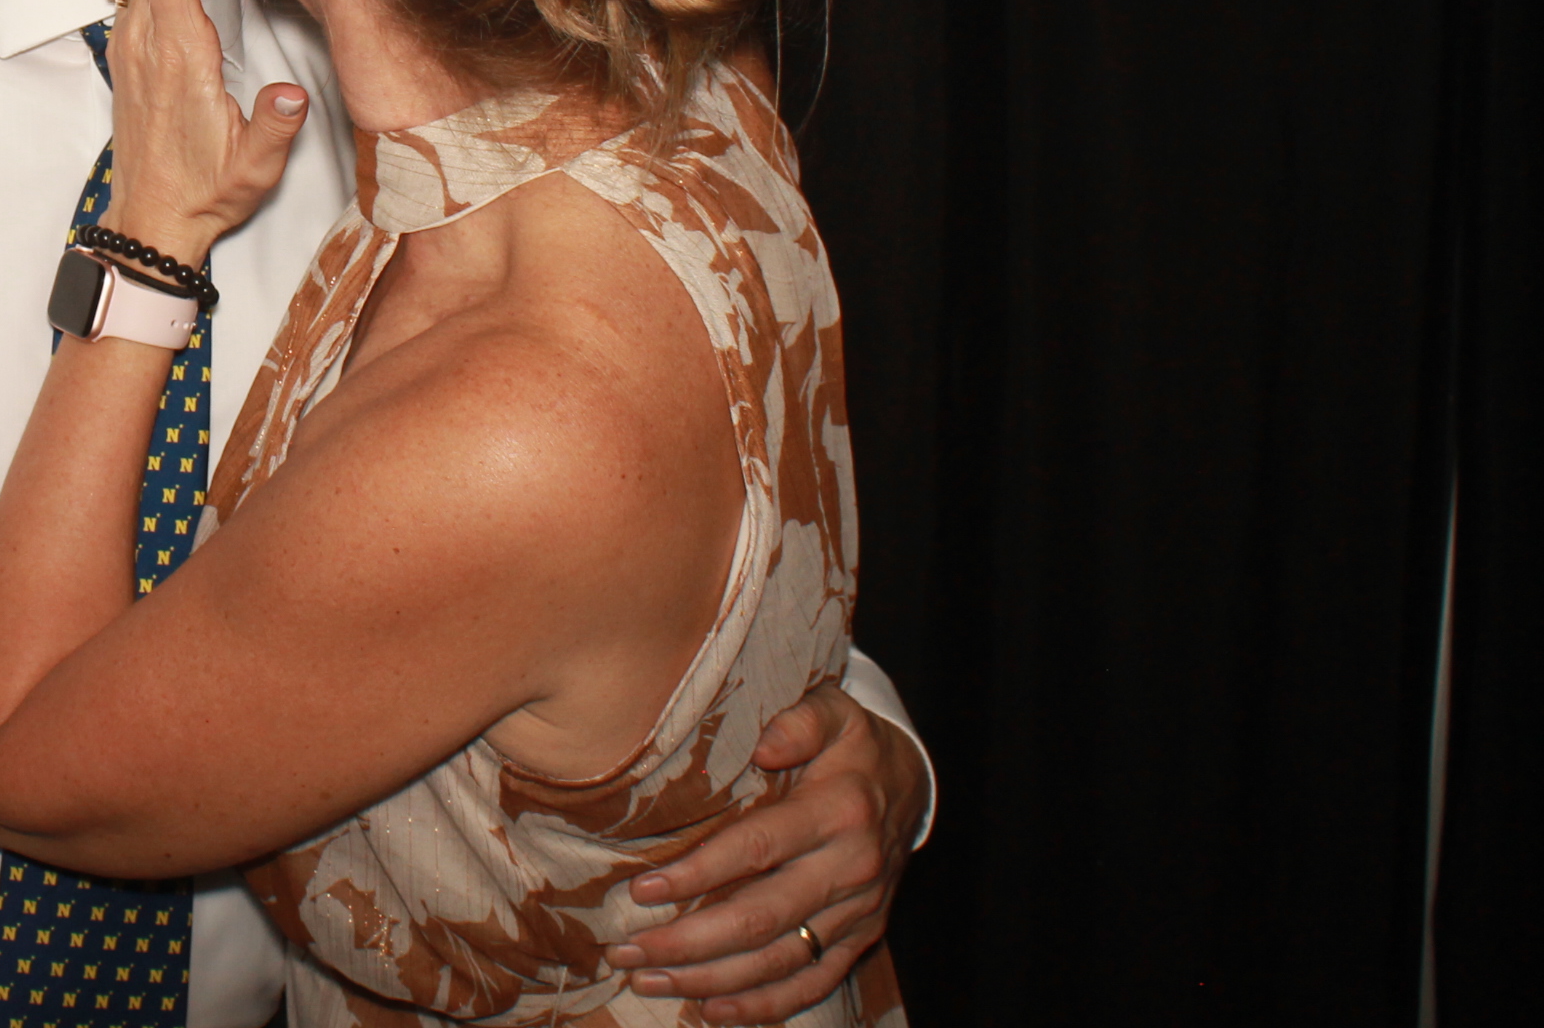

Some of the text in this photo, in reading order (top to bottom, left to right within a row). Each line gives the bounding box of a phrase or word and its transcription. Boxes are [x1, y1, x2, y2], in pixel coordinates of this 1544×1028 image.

[187, 334, 202, 349] N
[173, 366, 186, 380] N
[184, 397, 198, 412] N
[167, 428, 181, 443] N
[148, 456, 194, 473] N N
[163, 488, 205, 505] N N
[144, 517, 189, 535] N N
[158, 551, 171, 565] N
[139, 579, 153, 594] N
[10, 867, 58, 886] N N
[23, 900, 38, 915] N
[57, 904, 72, 918] N
[91, 907, 105, 921] N
[124, 910, 138, 924] N
[156, 912, 170, 926] N
[2, 926, 182, 955] N N N N N N
[17, 959, 32, 974] N
[51, 963, 65, 977] N
[84, 965, 98, 980] N
[117, 968, 131, 982] N
[149, 970, 163, 983] N
[30, 991, 45, 1005] N
[63, 993, 77, 1008] N
[96, 995, 109, 1009] N
[129, 997, 143, 1010] N
[162, 998, 175, 1011] N
